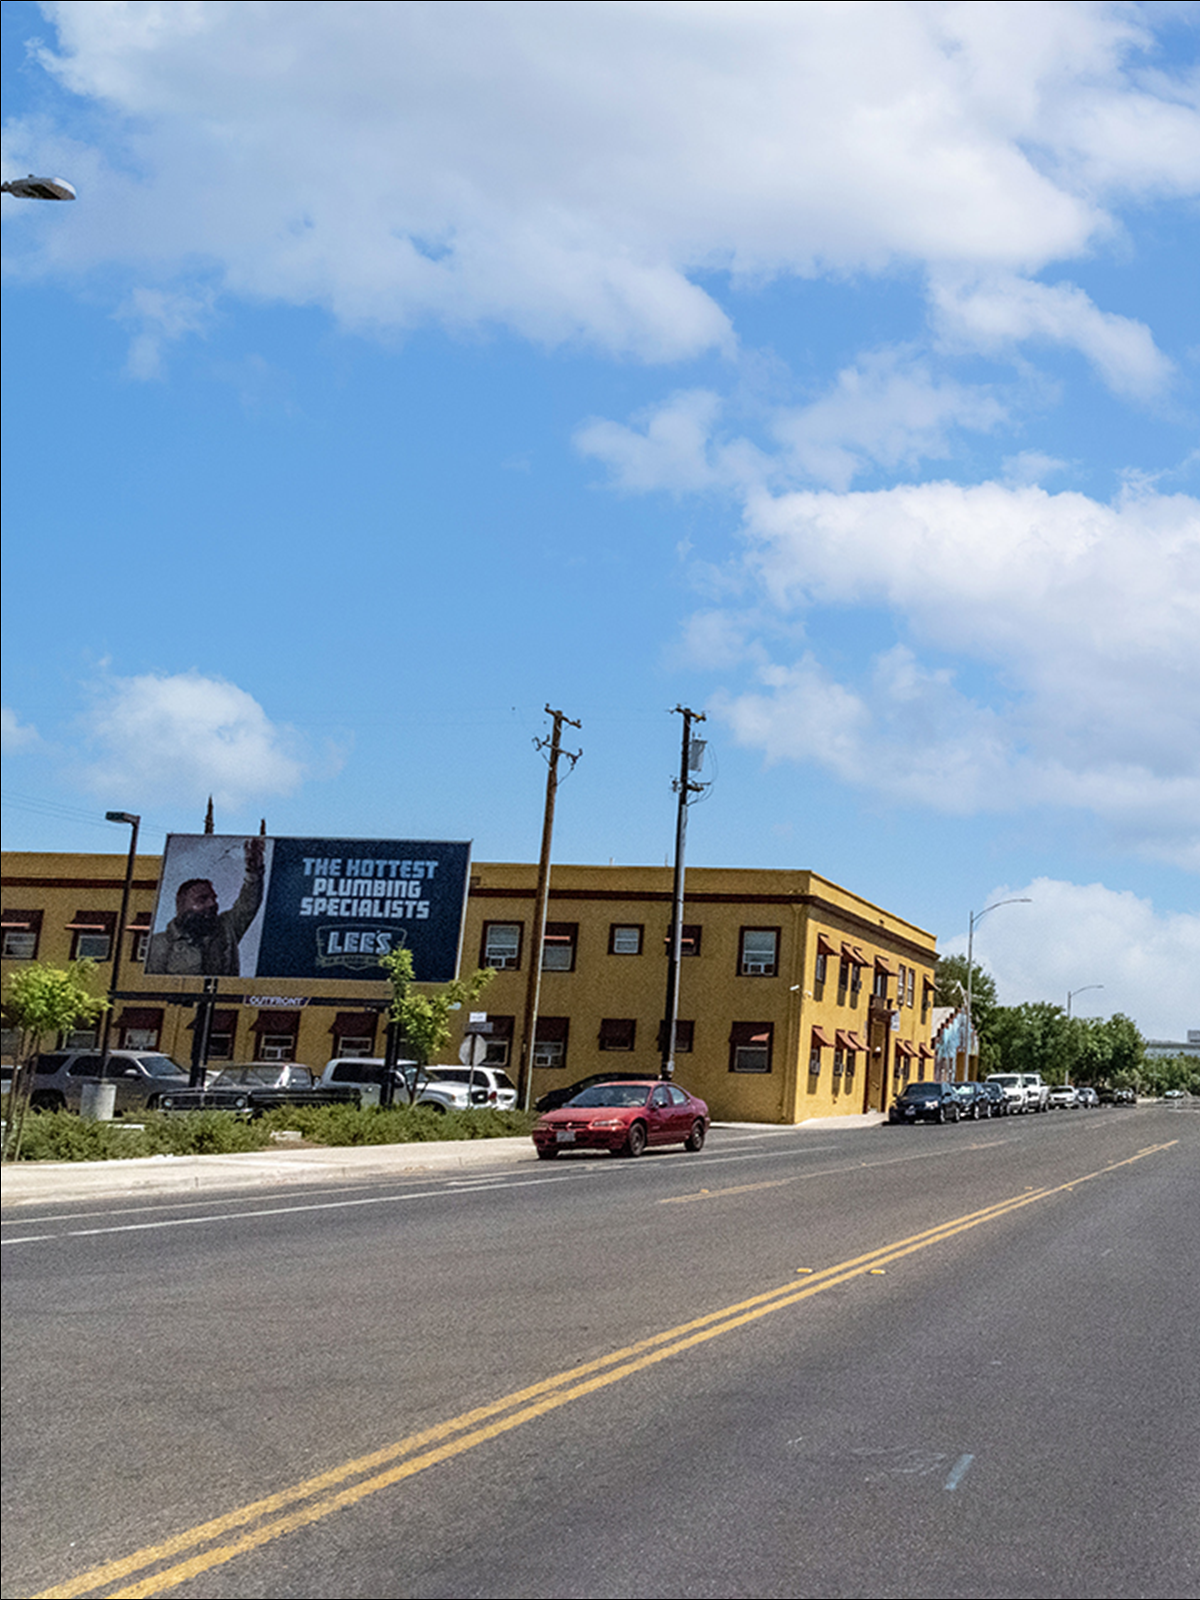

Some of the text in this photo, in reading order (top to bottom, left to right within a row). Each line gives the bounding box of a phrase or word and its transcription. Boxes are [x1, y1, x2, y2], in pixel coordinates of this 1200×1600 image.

[302, 857, 439, 879] THE HOTTEST
[312, 877, 421, 898] PLUMBING
[300, 896, 430, 919] SPECIALISTS
[326, 929, 392, 955] LEE'S
[249, 995, 304, 1007] OUTFRONT
